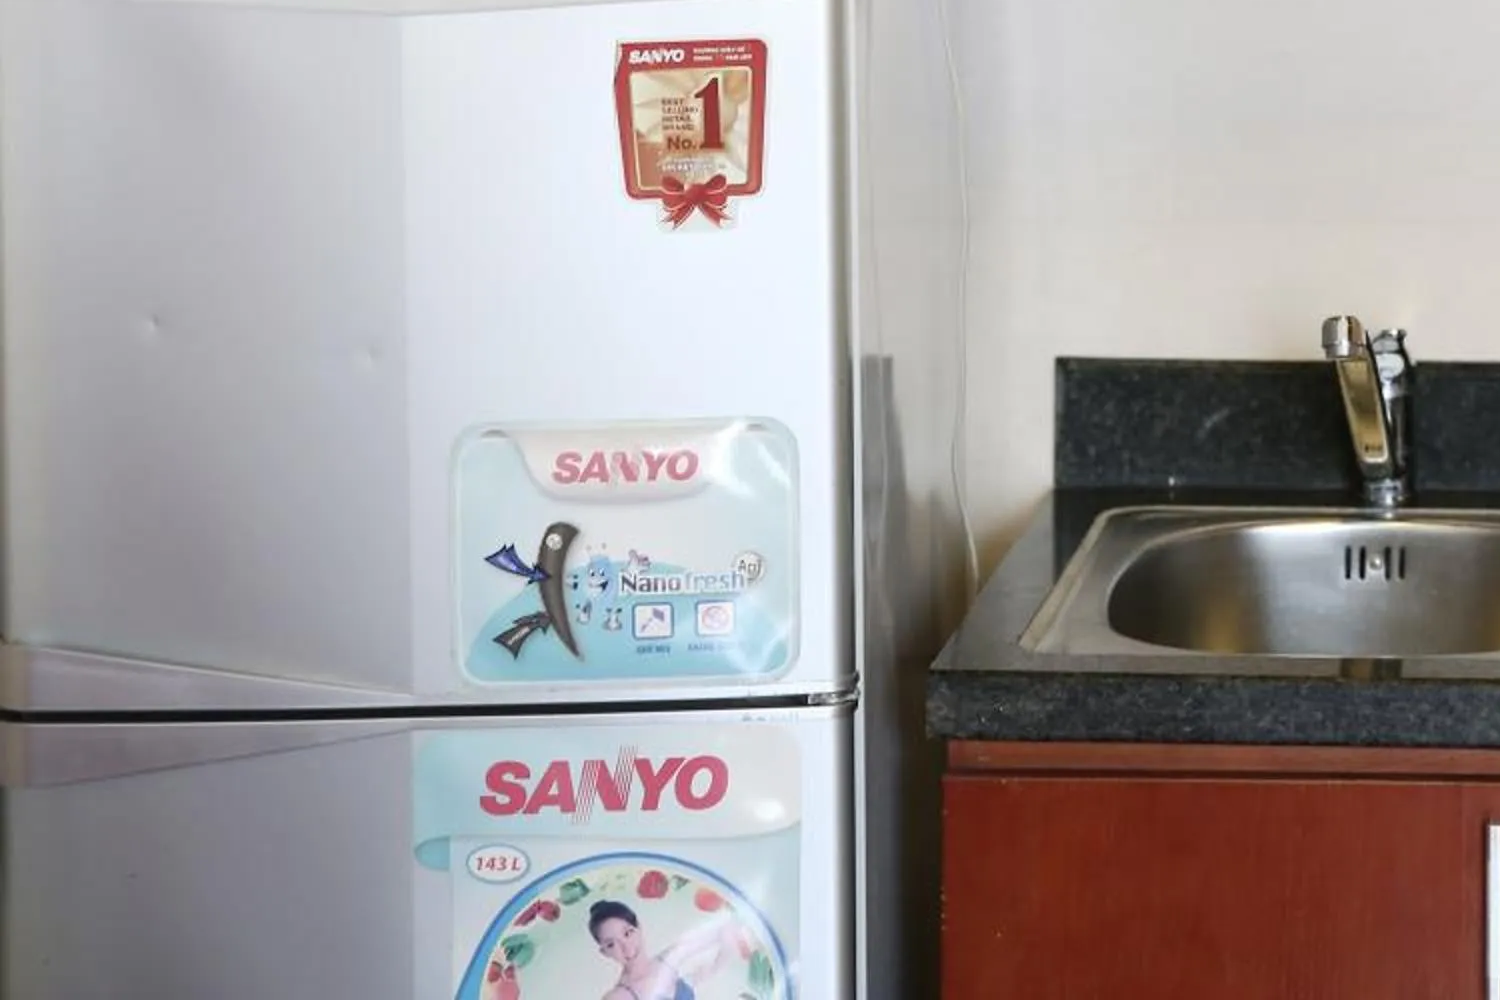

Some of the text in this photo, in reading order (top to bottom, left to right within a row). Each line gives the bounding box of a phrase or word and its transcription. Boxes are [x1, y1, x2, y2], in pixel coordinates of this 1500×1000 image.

[629, 49, 685, 64] SANYO
[667, 136, 697, 150] No.
[694, 77, 726, 149] 1
[552, 450, 698, 484] SANYO
[480, 749, 729, 820] SANYO
[476, 856, 507, 871] 143
